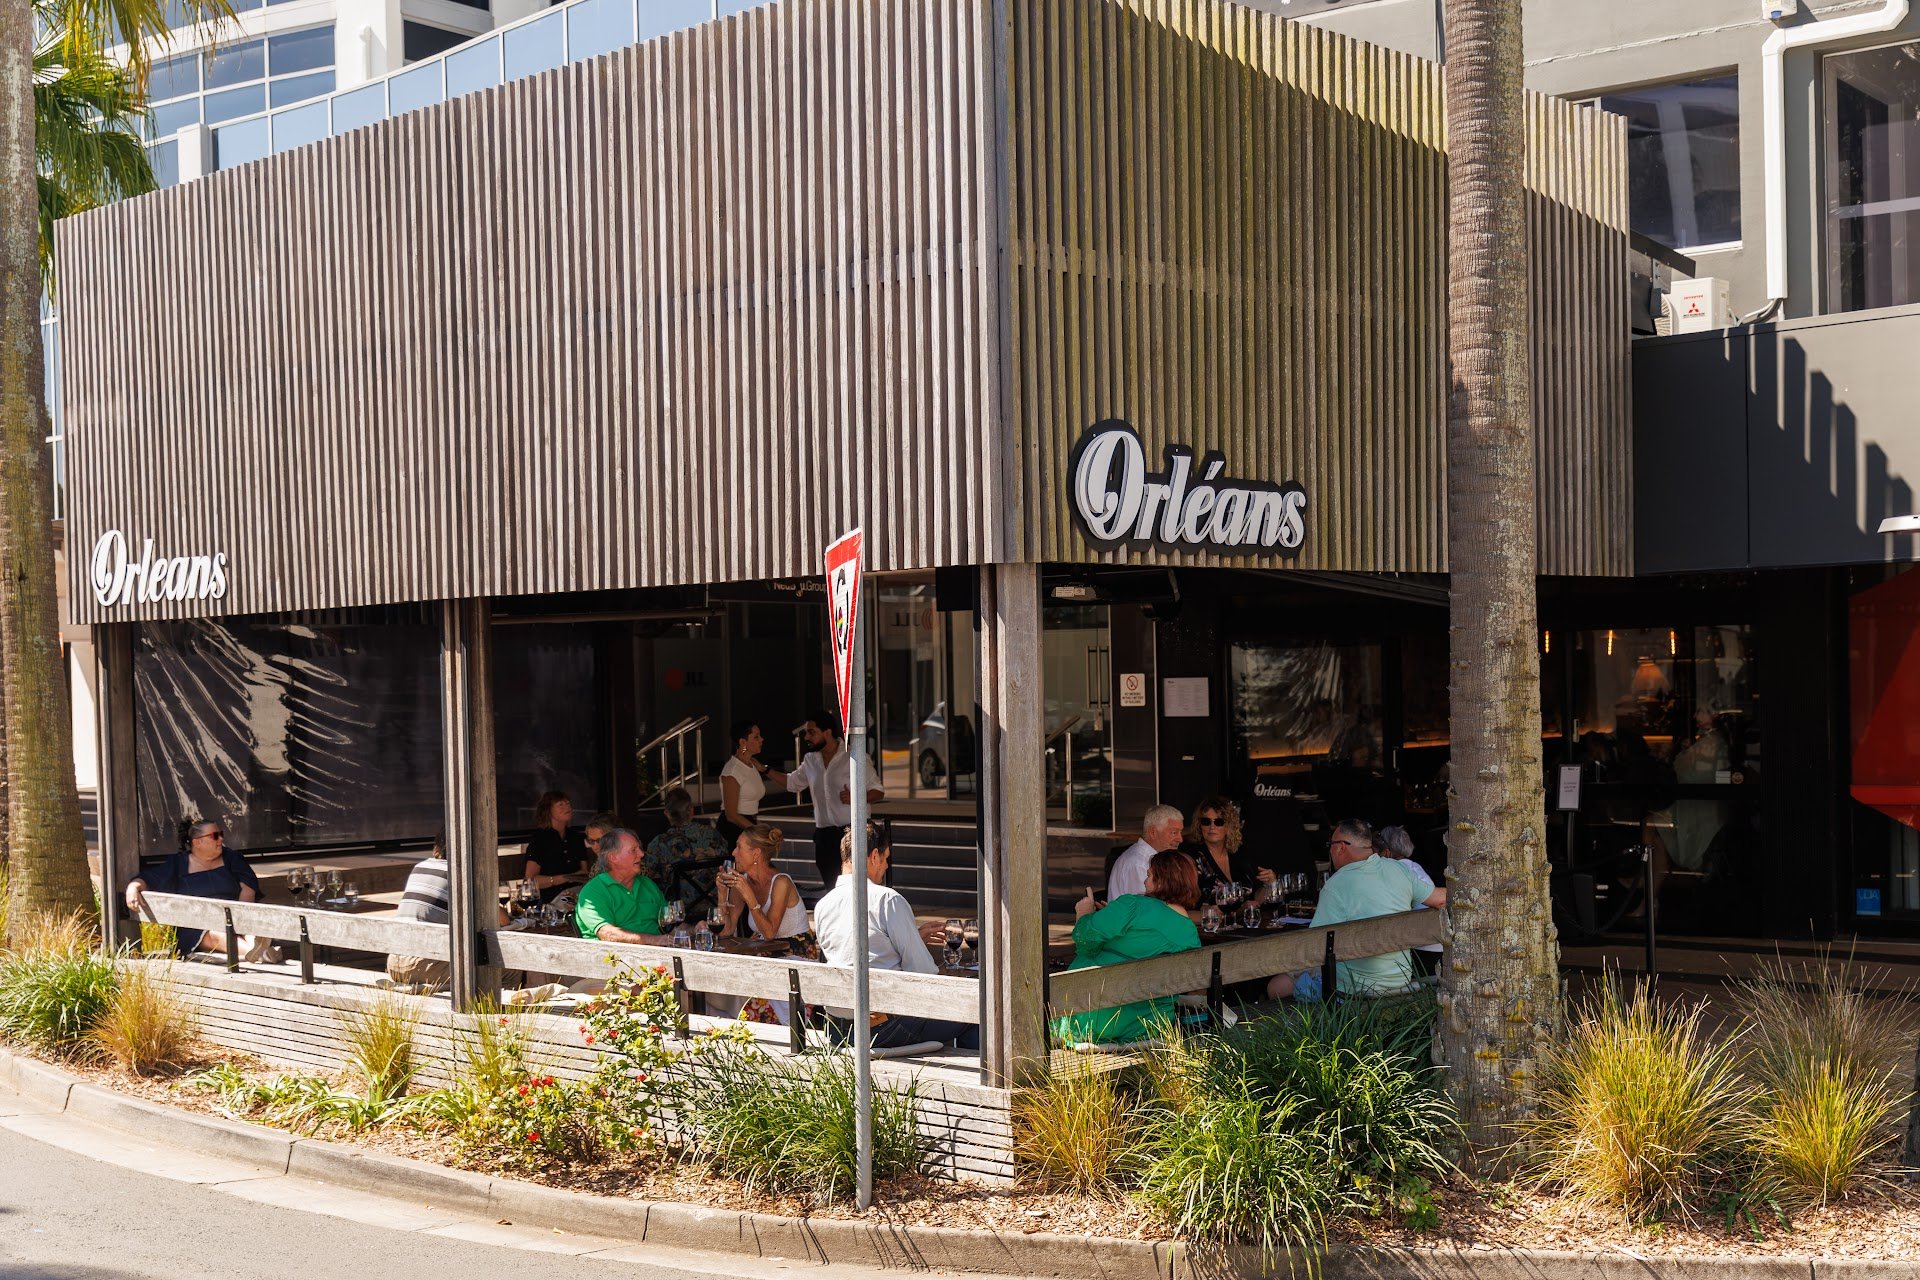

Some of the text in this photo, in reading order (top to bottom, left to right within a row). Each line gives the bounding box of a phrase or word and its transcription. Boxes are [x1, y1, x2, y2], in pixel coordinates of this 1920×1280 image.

[1075, 430, 1306, 548] Orléans
[91, 529, 227, 607] Orleans
[1254, 782, 1292, 797] Orléans
